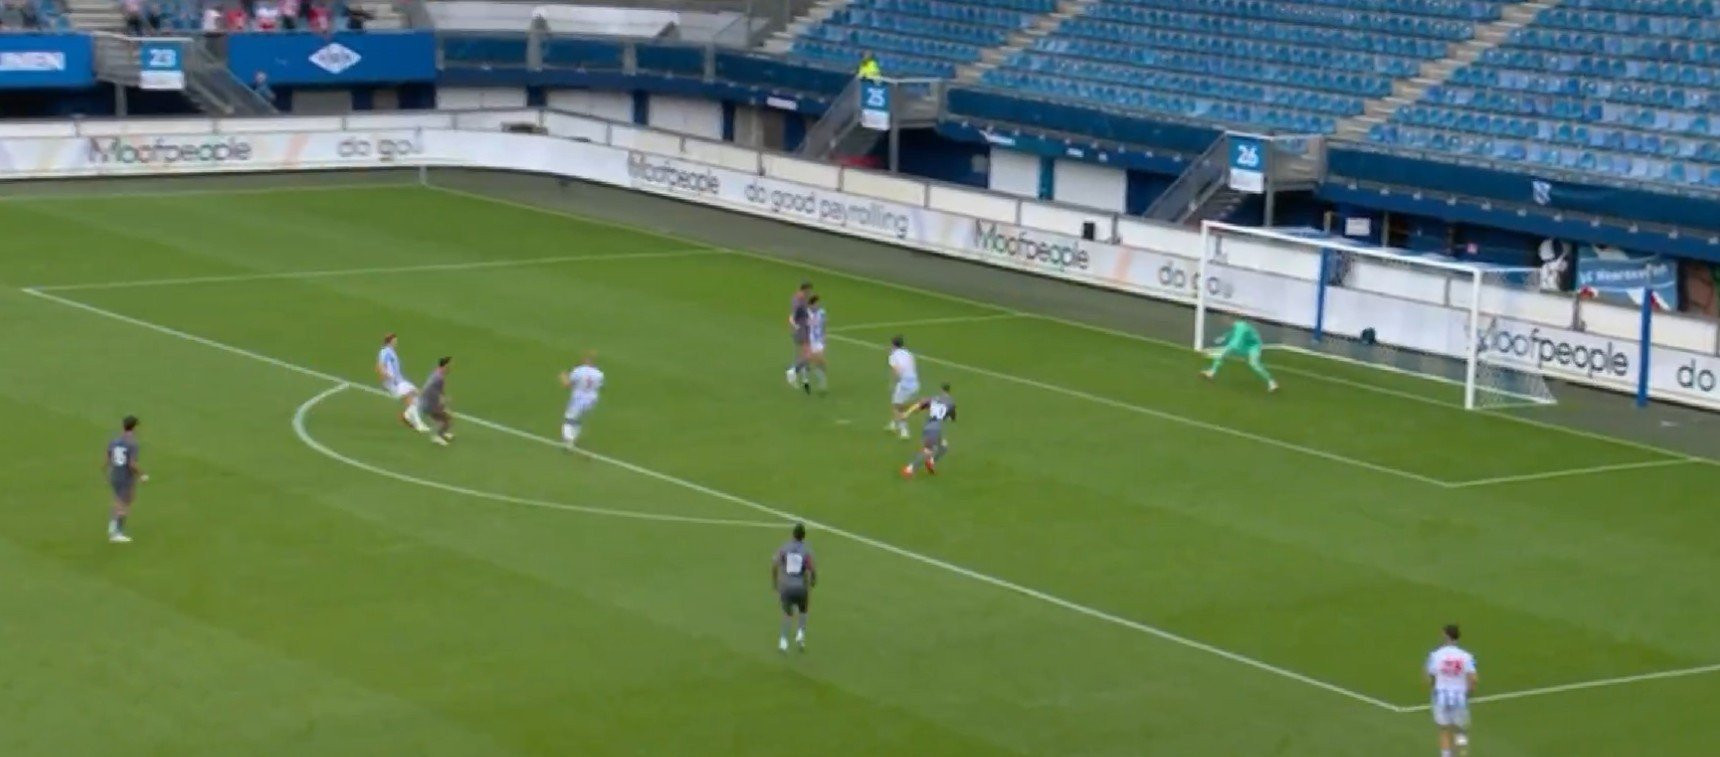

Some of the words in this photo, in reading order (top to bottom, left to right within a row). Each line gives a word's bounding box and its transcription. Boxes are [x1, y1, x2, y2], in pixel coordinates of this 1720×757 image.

[1237, 144, 1260, 167] 26
[770, 188, 816, 214] good
[1158, 260, 1186, 288] do
[1677, 358, 1715, 392] do
